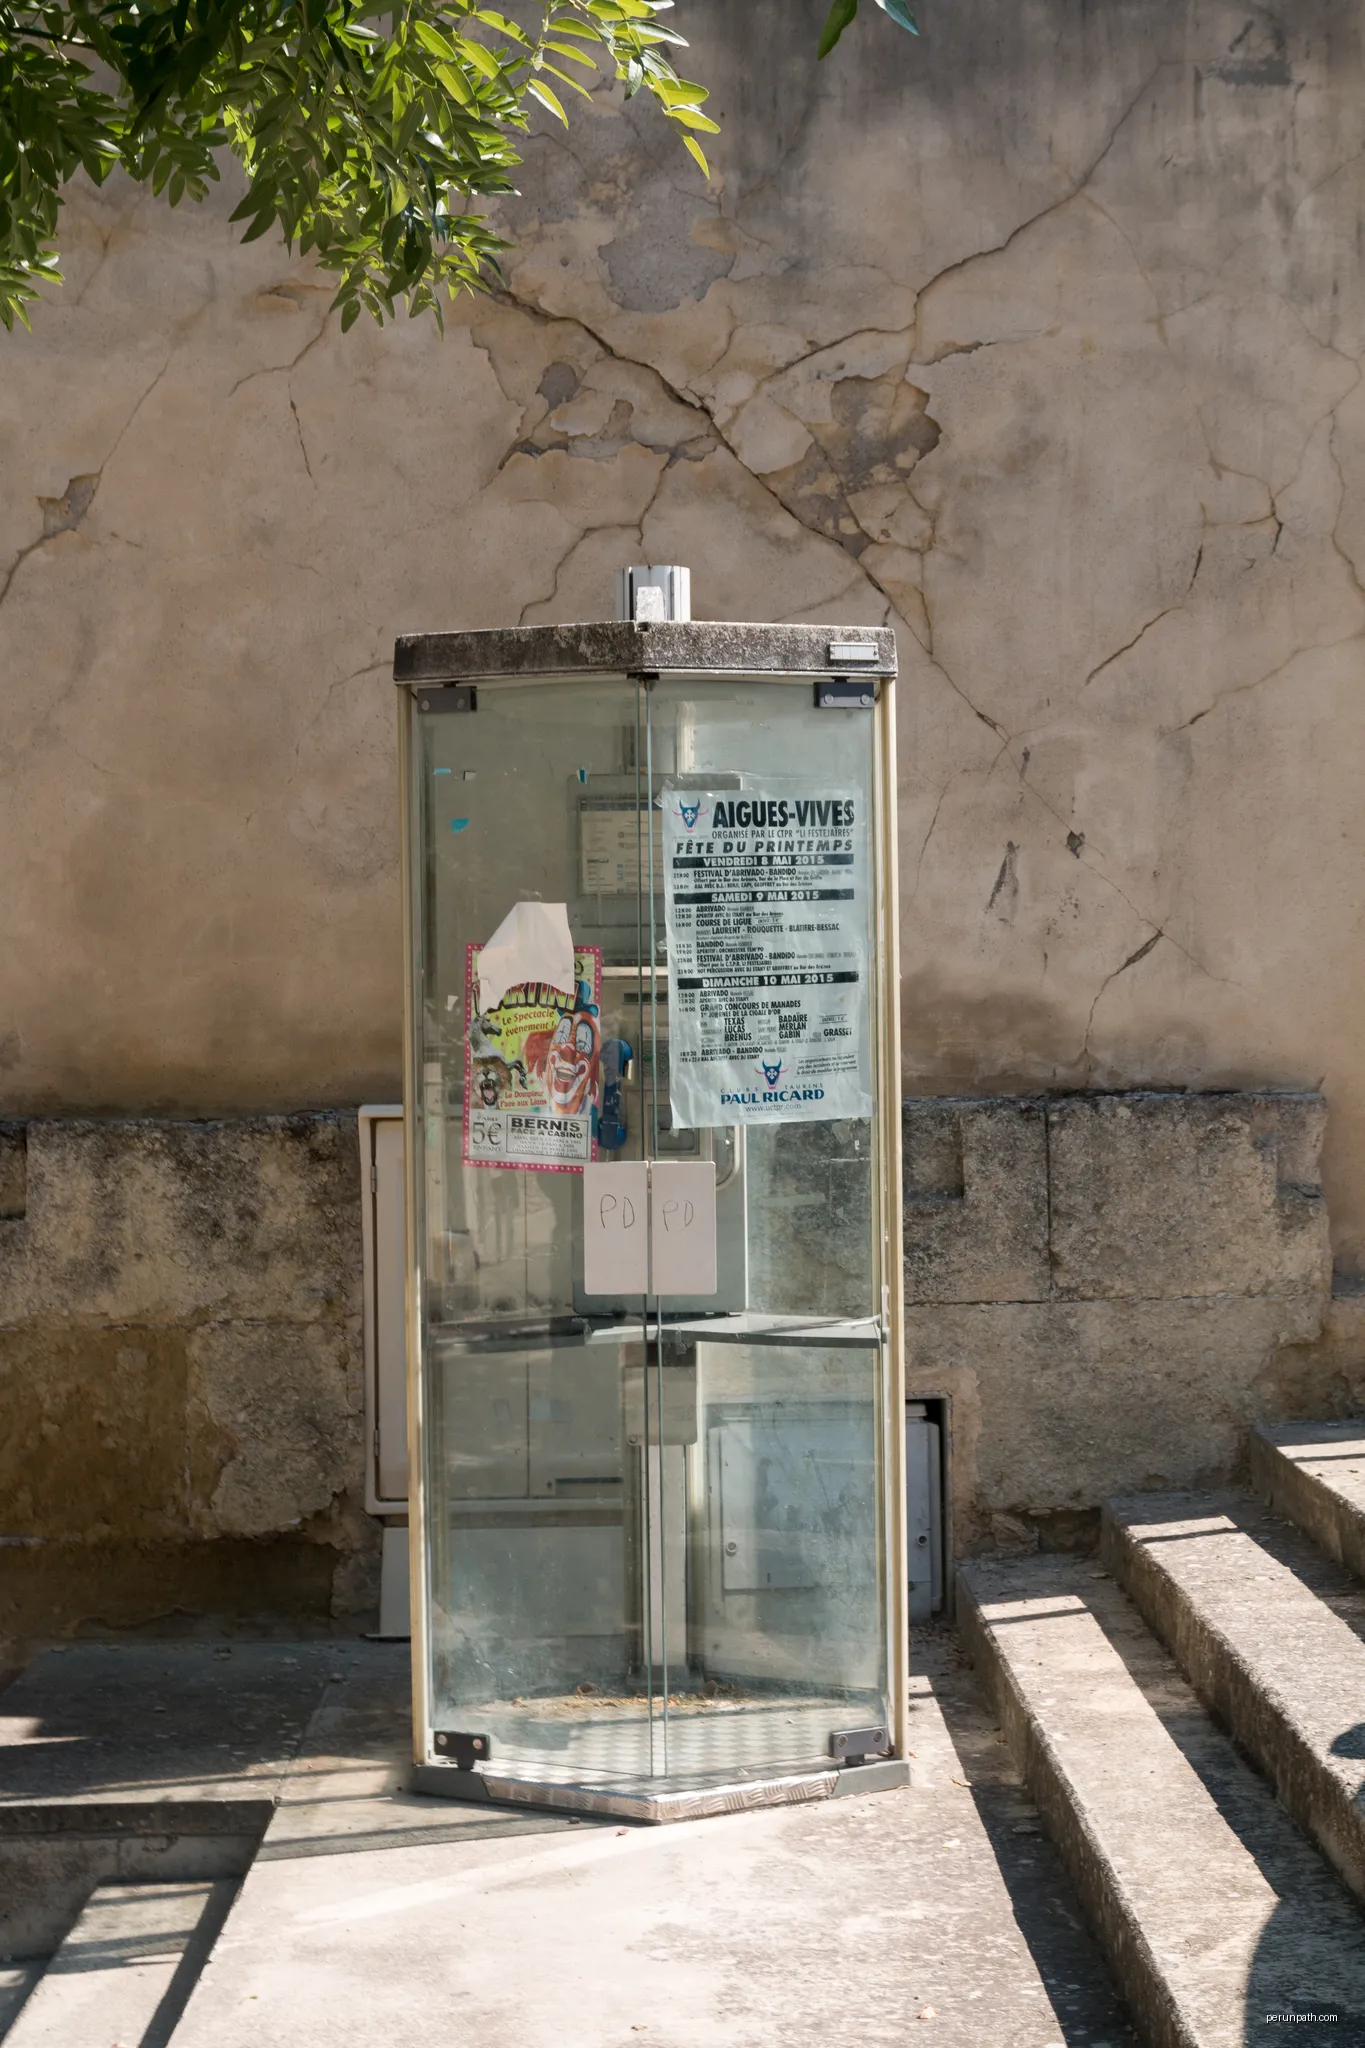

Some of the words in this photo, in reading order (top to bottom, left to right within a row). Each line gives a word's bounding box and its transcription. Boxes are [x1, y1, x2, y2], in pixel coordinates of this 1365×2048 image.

[712, 800, 855, 828] AIGUES-VIVES
[712, 829, 749, 839] ORGANISÉ
[751, 830, 765, 839] PAR
[768, 830, 775, 838] LE
[777, 829, 793, 838] CTPR
[676, 839, 714, 854] FÊTE
[723, 841, 746, 854] DU
[754, 840, 853, 853] PRINTEMPS
[703, 856, 758, 867] VENDREDI
[761, 856, 768, 866] 8
[772, 856, 792, 865] MAI
[795, 856, 824, 864] 2015
[694, 870, 722, 878] FESTIVAL
[724, 868, 764, 877] D'ABRIVADO
[769, 868, 796, 876] BANDIDO
[712, 892, 752, 902] SAMEDI
[756, 892, 764, 902] 9
[767, 891, 788, 900] MAI
[791, 891, 820, 900] 2015
[696, 919, 721, 927] COURSE
[723, 918, 731, 926] DE
[733, 918, 752, 926] LIGUE
[712, 926, 741, 935] LAURENT
[747, 925, 783, 934] ROUQUETTE
[696, 954, 724, 963] FESTIVAL
[725, 953, 764, 961] D'ABRIVADO
[769, 952, 796, 960] BANDIDO
[702, 976, 760, 988] DIMANCHE
[764, 975, 777, 985] 10
[781, 974, 800, 984] MAI
[805, 974, 834, 983] 2015
[725, 1002, 759, 1010] CONCOURS
[761, 1001, 769, 1009] DE
[771, 1000, 801, 1008] MANADES
[502, 1016, 512, 1026] Le
[514, 1009, 555, 1022] Spectacle
[724, 1017, 745, 1025] TEXAS
[724, 1025, 745, 1033] LUCAS
[779, 1022, 806, 1031] MERLAN
[779, 1030, 800, 1039] GABIN
[824, 1028, 852, 1036] GRASSET
[720, 1092, 760, 1105] PAUL
[763, 1088, 825, 1103] RICARD
[511, 1118, 580, 1132] BERNIS
[472, 1122, 502, 1146] 5€
[548, 1131, 583, 1139] CASINO
